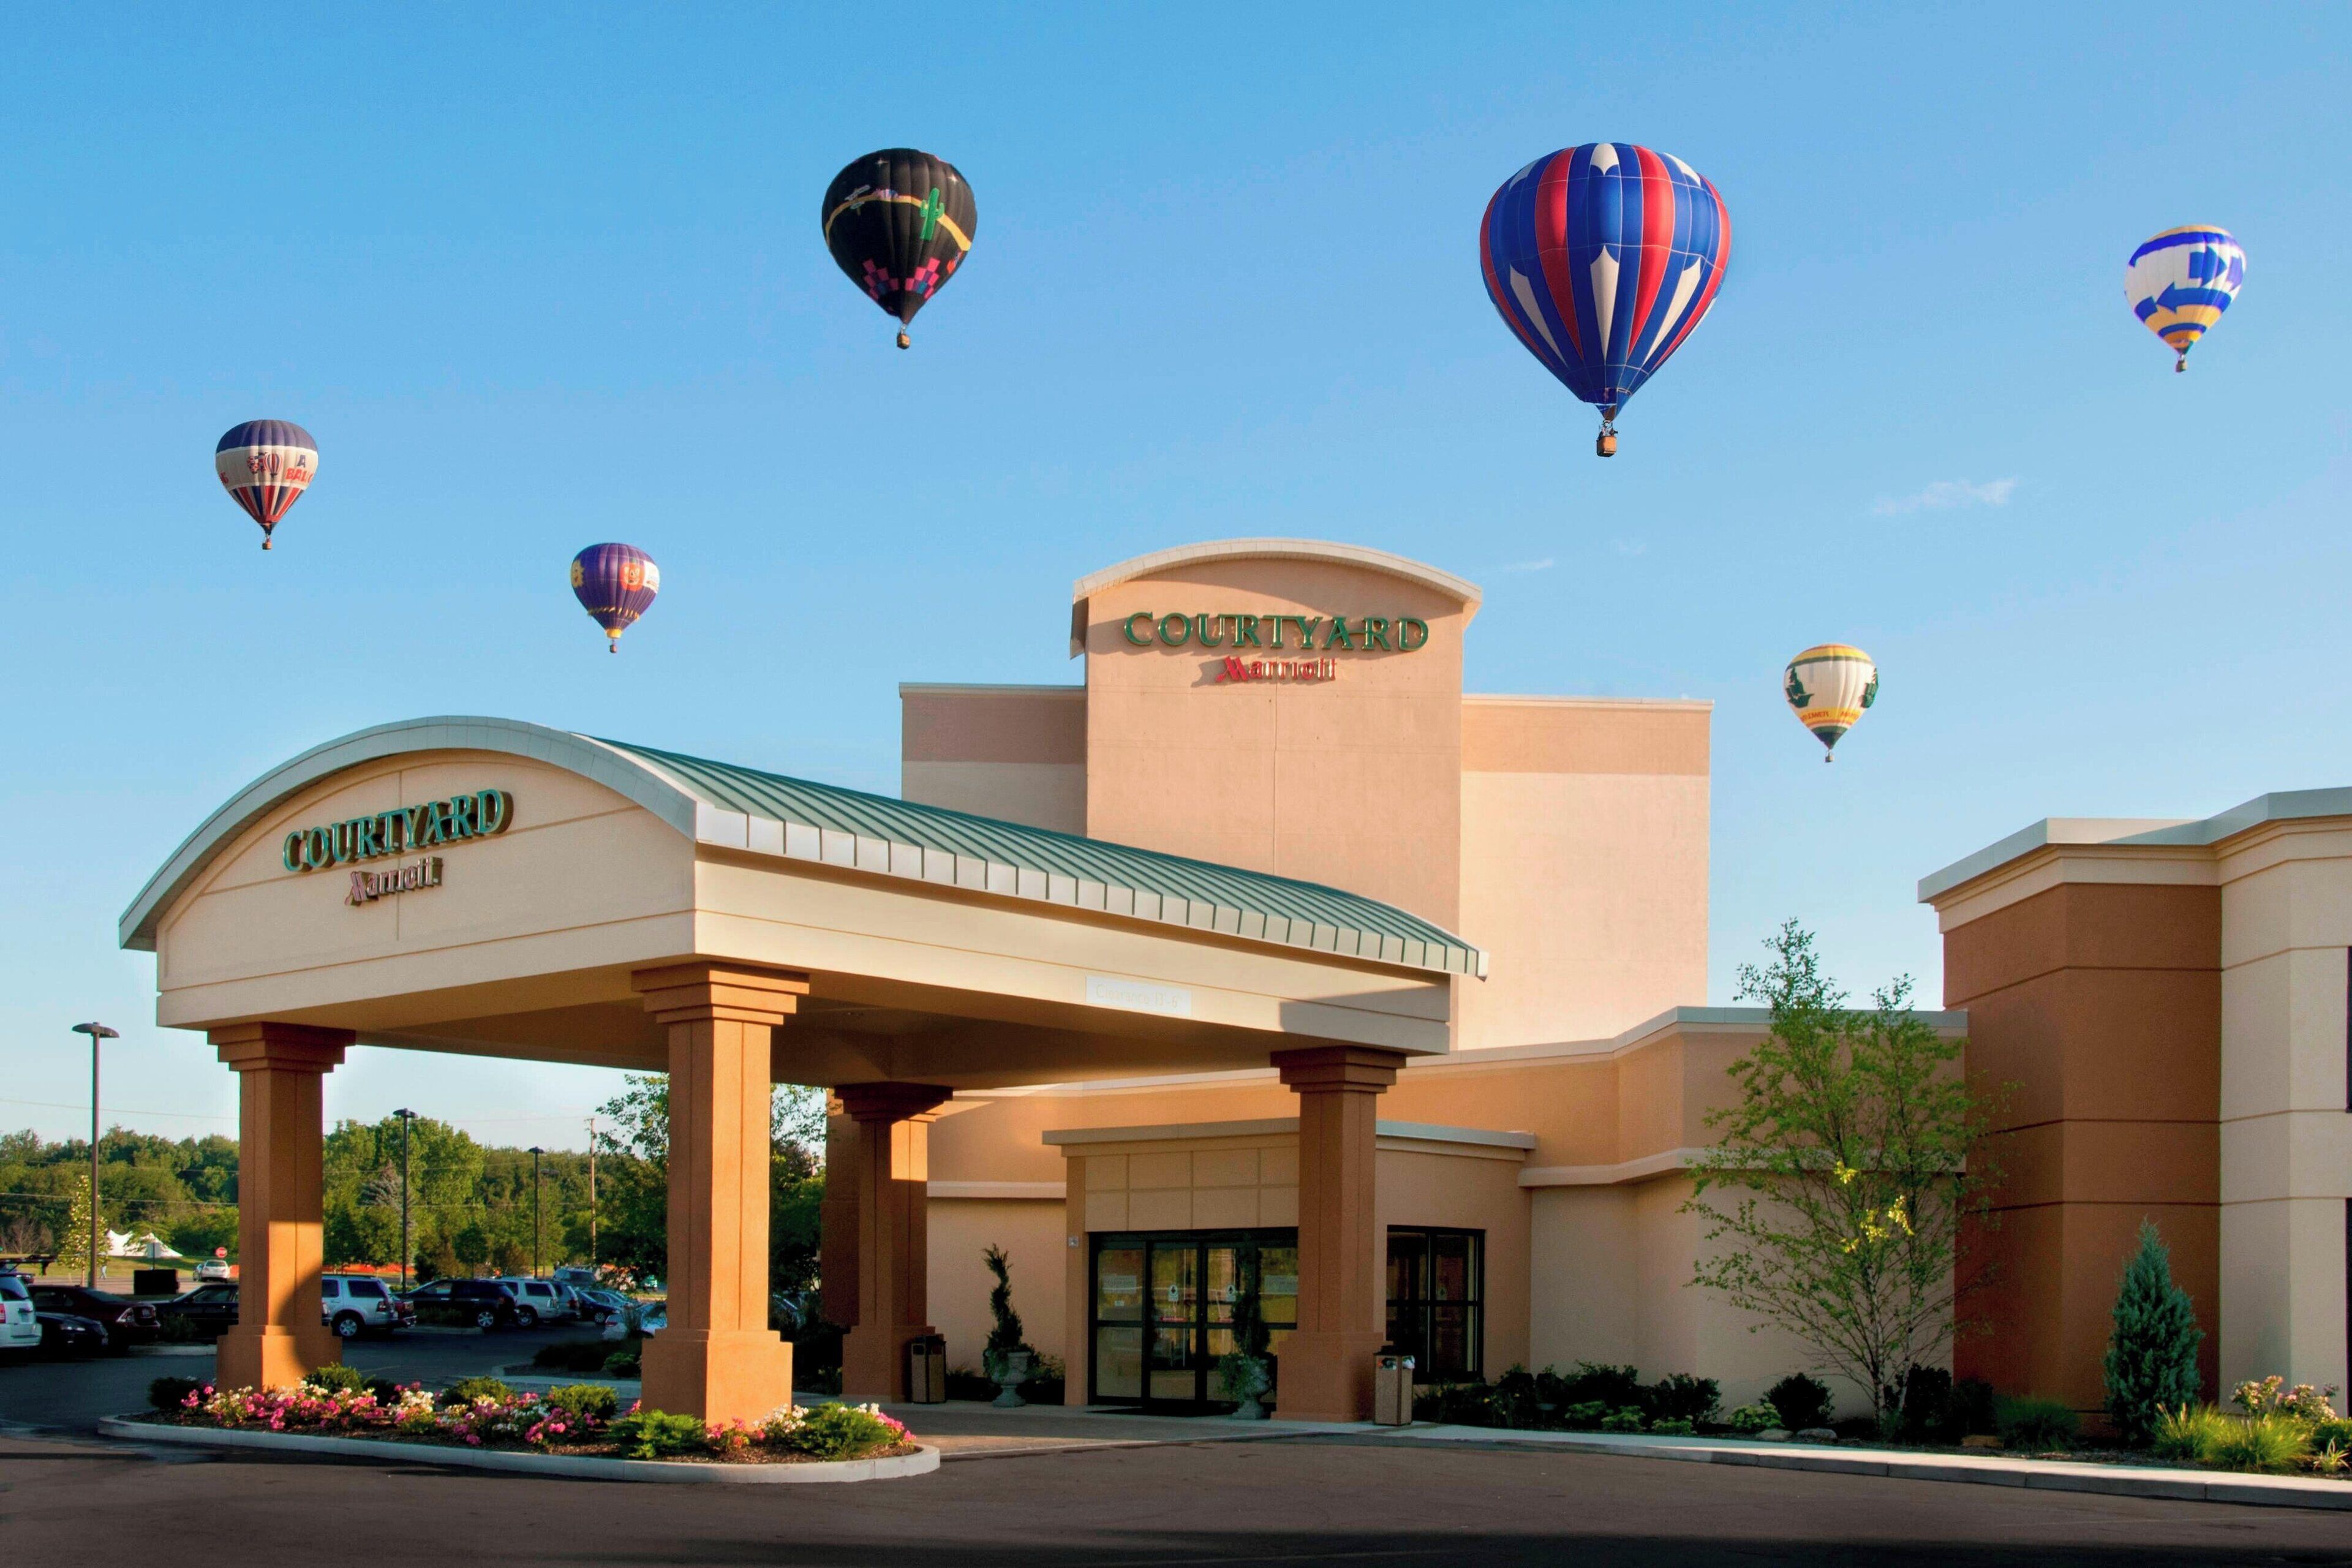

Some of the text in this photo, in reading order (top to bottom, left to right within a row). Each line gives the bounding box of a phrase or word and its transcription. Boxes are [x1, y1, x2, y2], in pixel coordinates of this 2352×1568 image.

[296, 454, 306, 468] A
[1125, 612, 1429, 651] COURTYARD
[1216, 656, 1336, 681] Marriott
[283, 789, 508, 872] COURTYARD
[344, 856, 437, 906] Marriott
